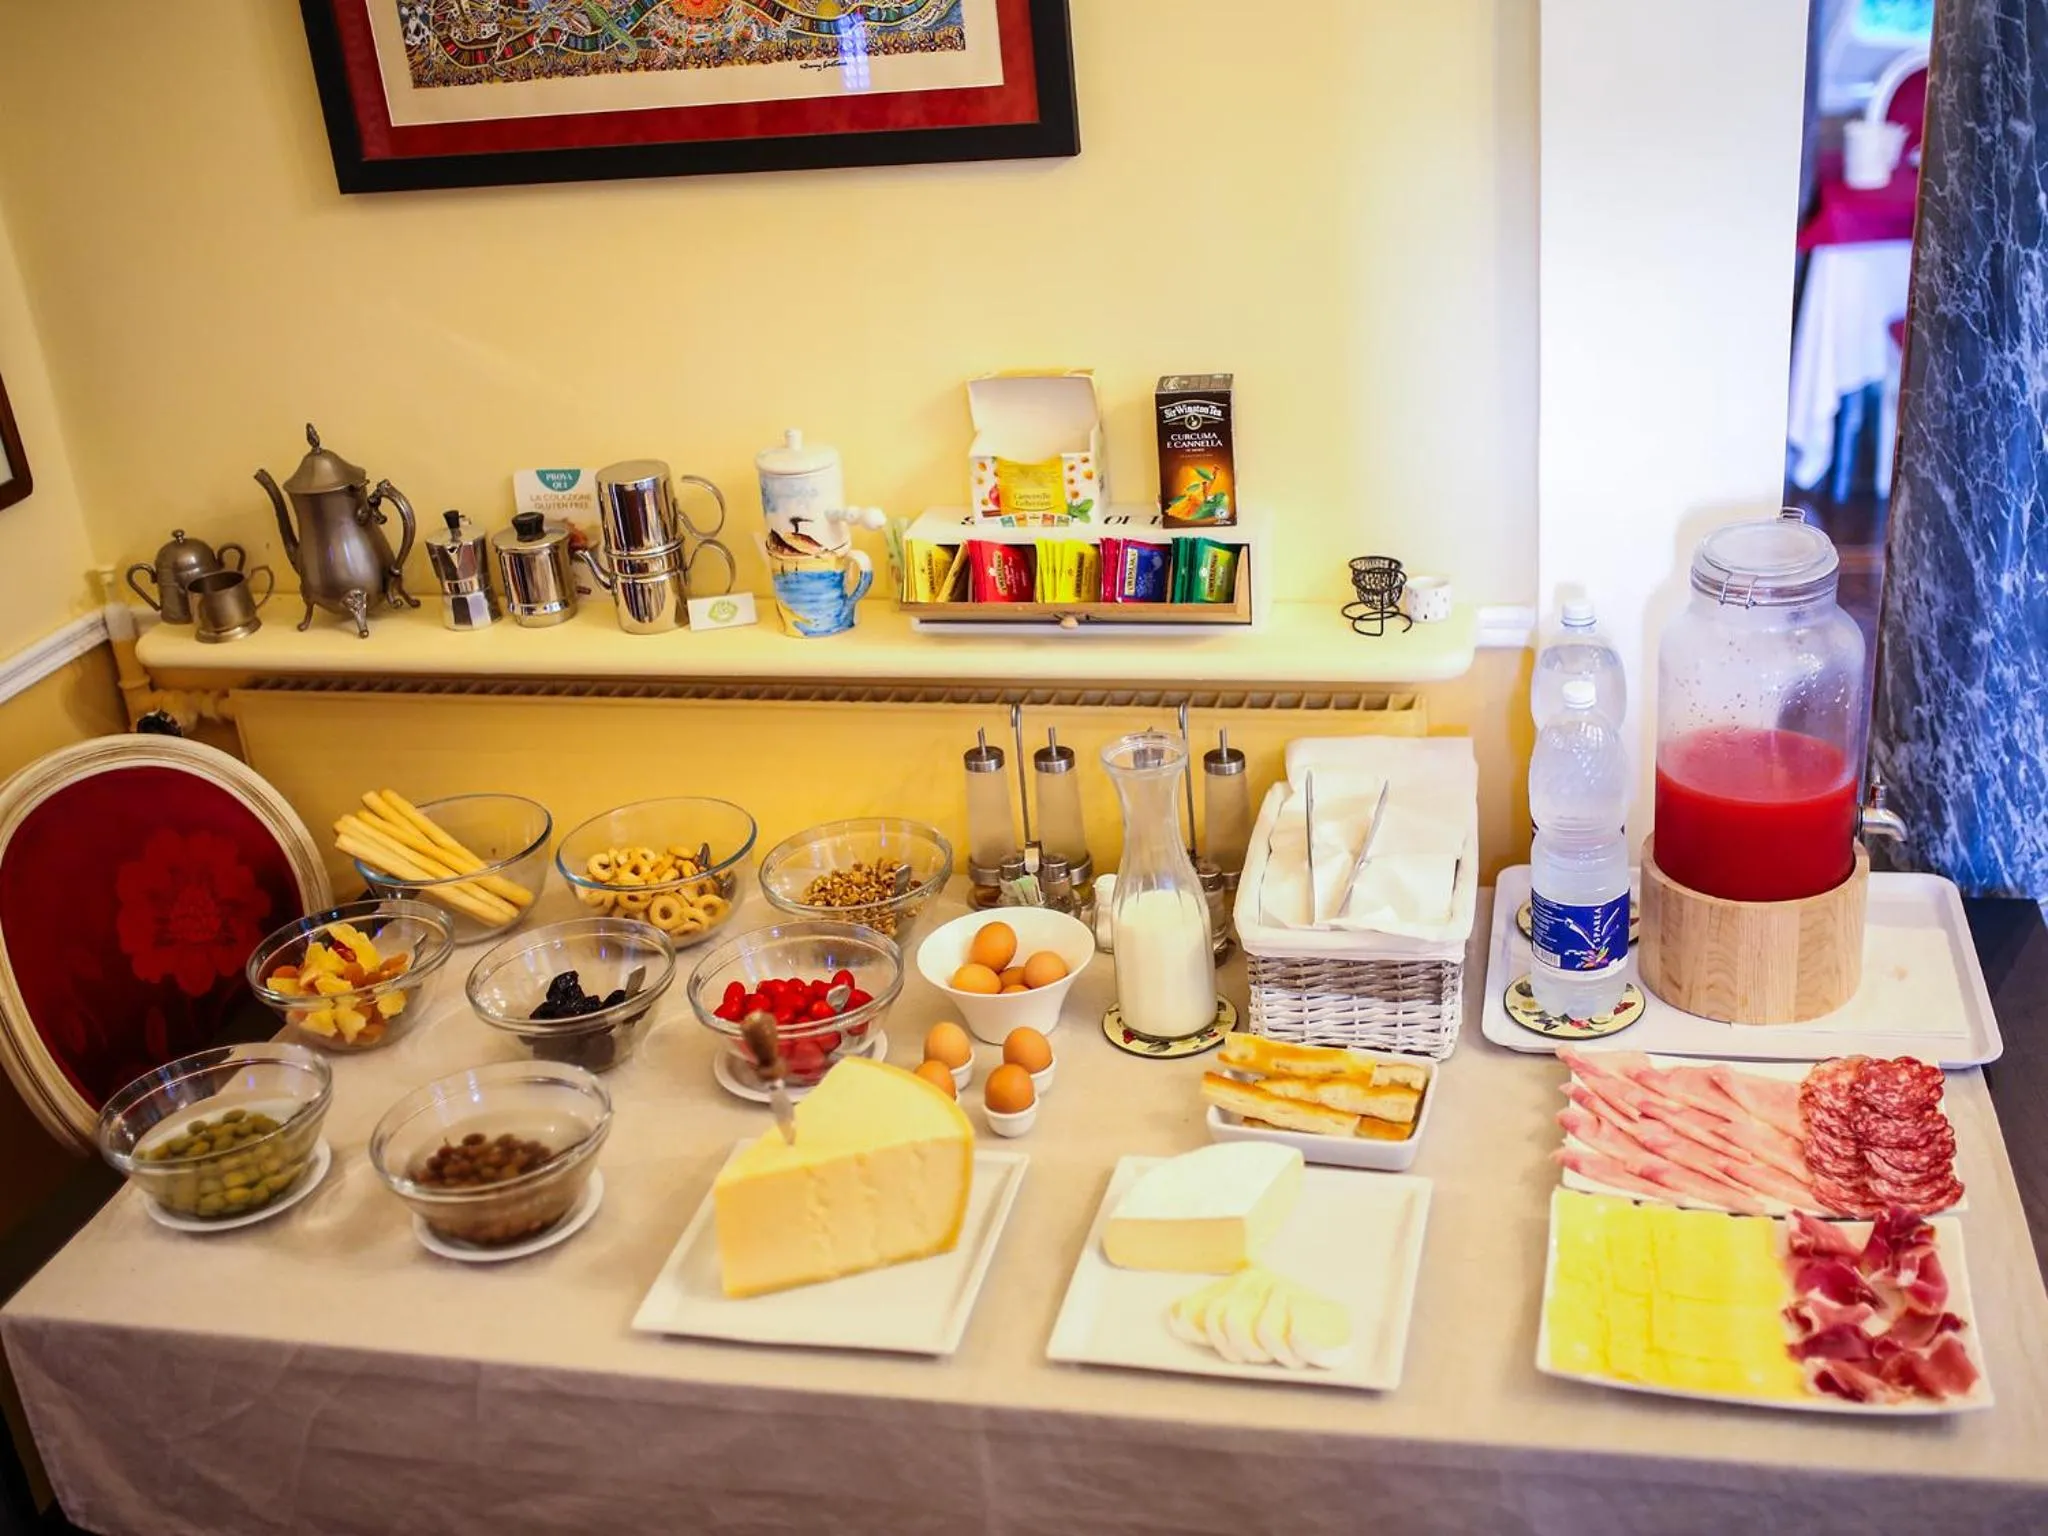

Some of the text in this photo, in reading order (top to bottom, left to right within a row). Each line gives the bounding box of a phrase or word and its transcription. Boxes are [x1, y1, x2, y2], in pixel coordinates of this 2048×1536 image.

[1170, 432, 1218, 441] CURCUMA
[1166, 440, 1223, 449] E CANNELLA
[545, 472, 573, 481] PROVA
[552, 481, 568, 489] QUI
